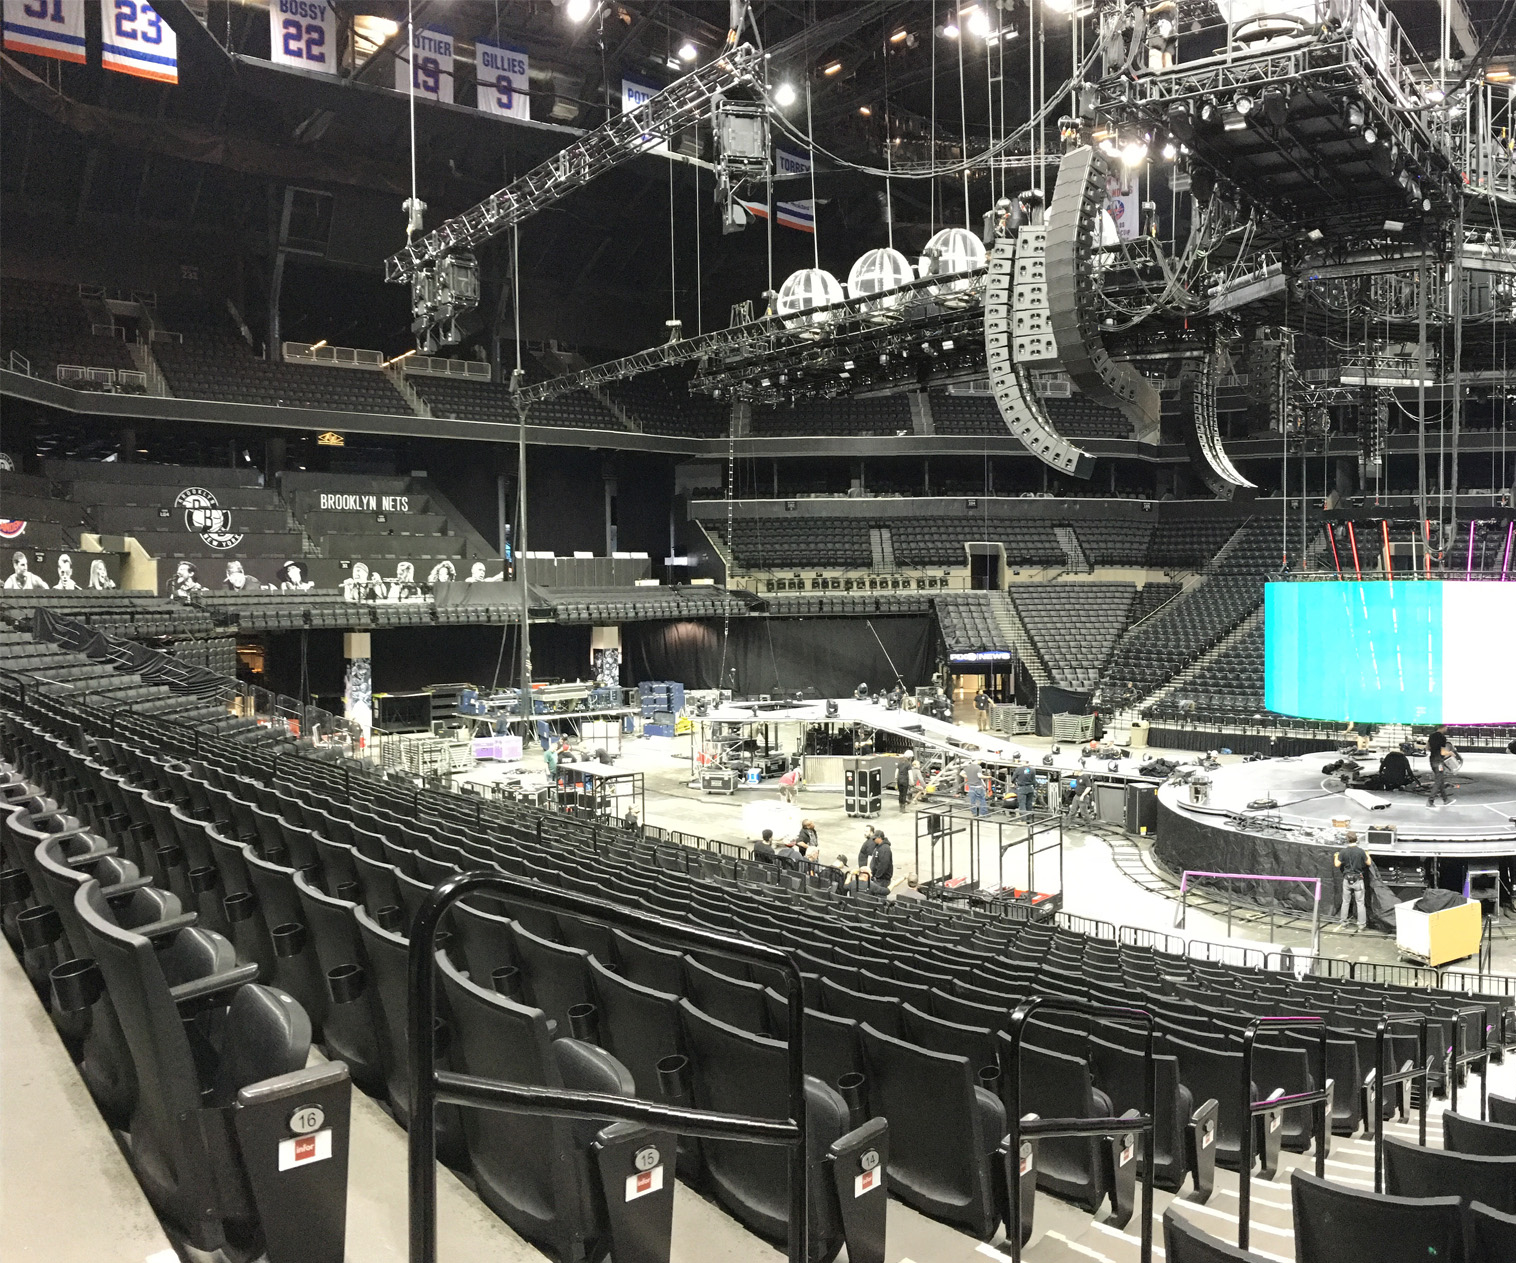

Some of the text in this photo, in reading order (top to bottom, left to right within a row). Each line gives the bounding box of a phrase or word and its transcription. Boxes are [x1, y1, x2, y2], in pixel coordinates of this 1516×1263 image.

[280, 0, 326, 22] BOSSY
[115, 0, 163, 45] 23
[282, 18, 326, 63] 22
[482, 51, 526, 75] GILLIES
[496, 74, 513, 110] 9
[178, 489, 215, 504] BROOKLYN
[320, 493, 409, 512] BROOKLYN NETS
[299, 1112, 317, 1129] 16
[296, 1143, 315, 1154] infor
[641, 1152, 654, 1167] 15
[866, 1154, 875, 1166] 14
